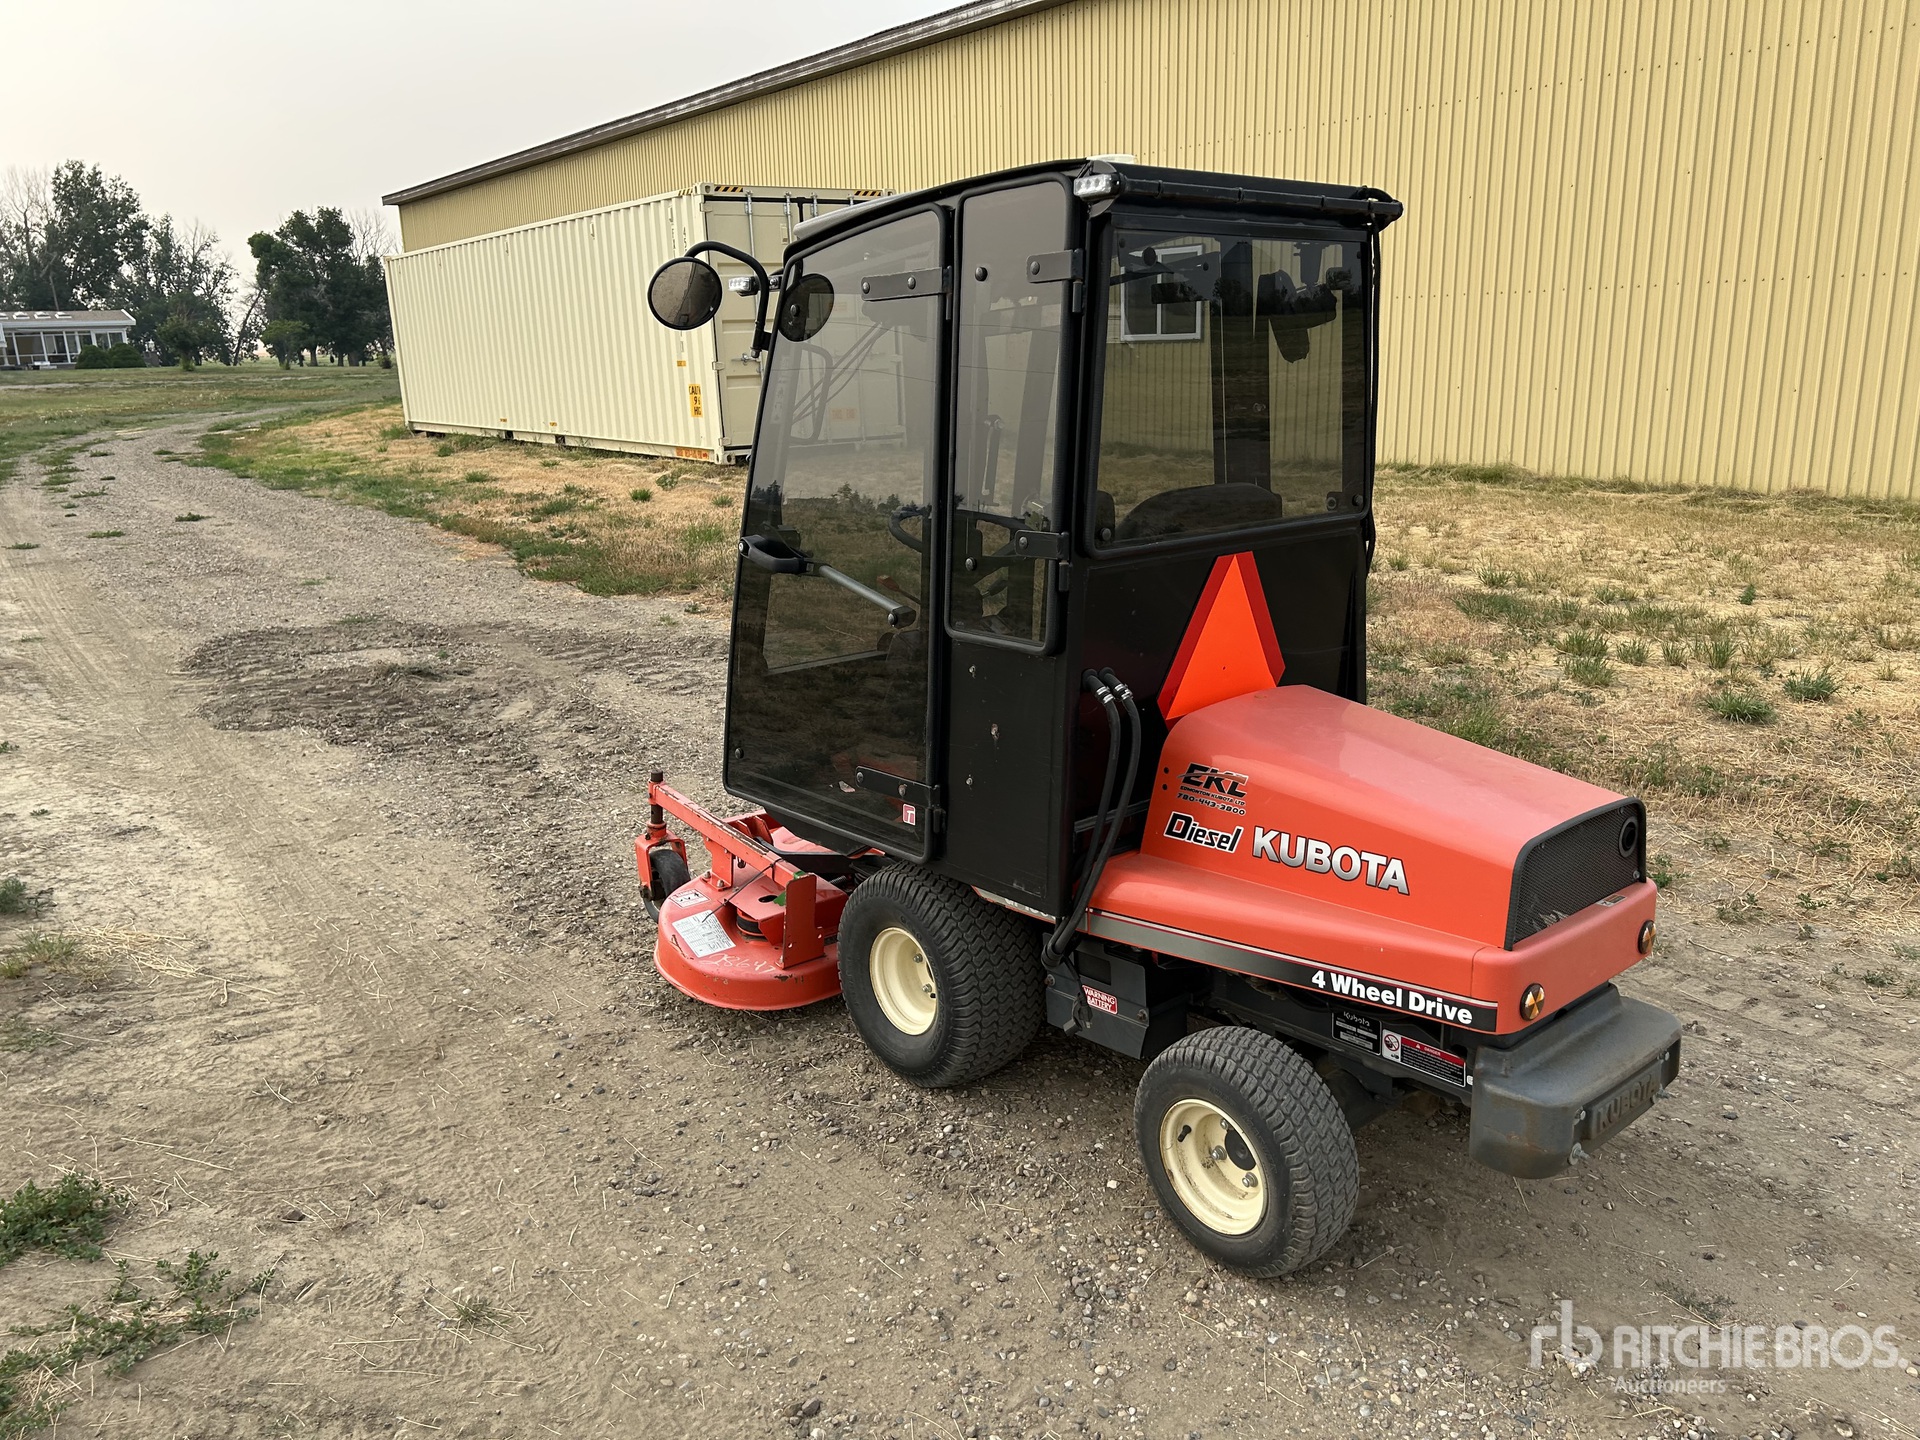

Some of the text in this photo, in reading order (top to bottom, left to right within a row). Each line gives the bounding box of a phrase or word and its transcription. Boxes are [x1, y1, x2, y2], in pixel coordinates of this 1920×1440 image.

[1179, 785, 1210, 797] EDMONTON
[1210, 793, 1234, 803] KUBOTA
[1164, 811, 1244, 853] Diesel
[1252, 825, 1410, 896] KUBOTA
[1084, 988, 1116, 1005] WARNING
[1086, 996, 1113, 1012] BATTERY
[1311, 969, 1473, 1025] 4 Wheel Drive
